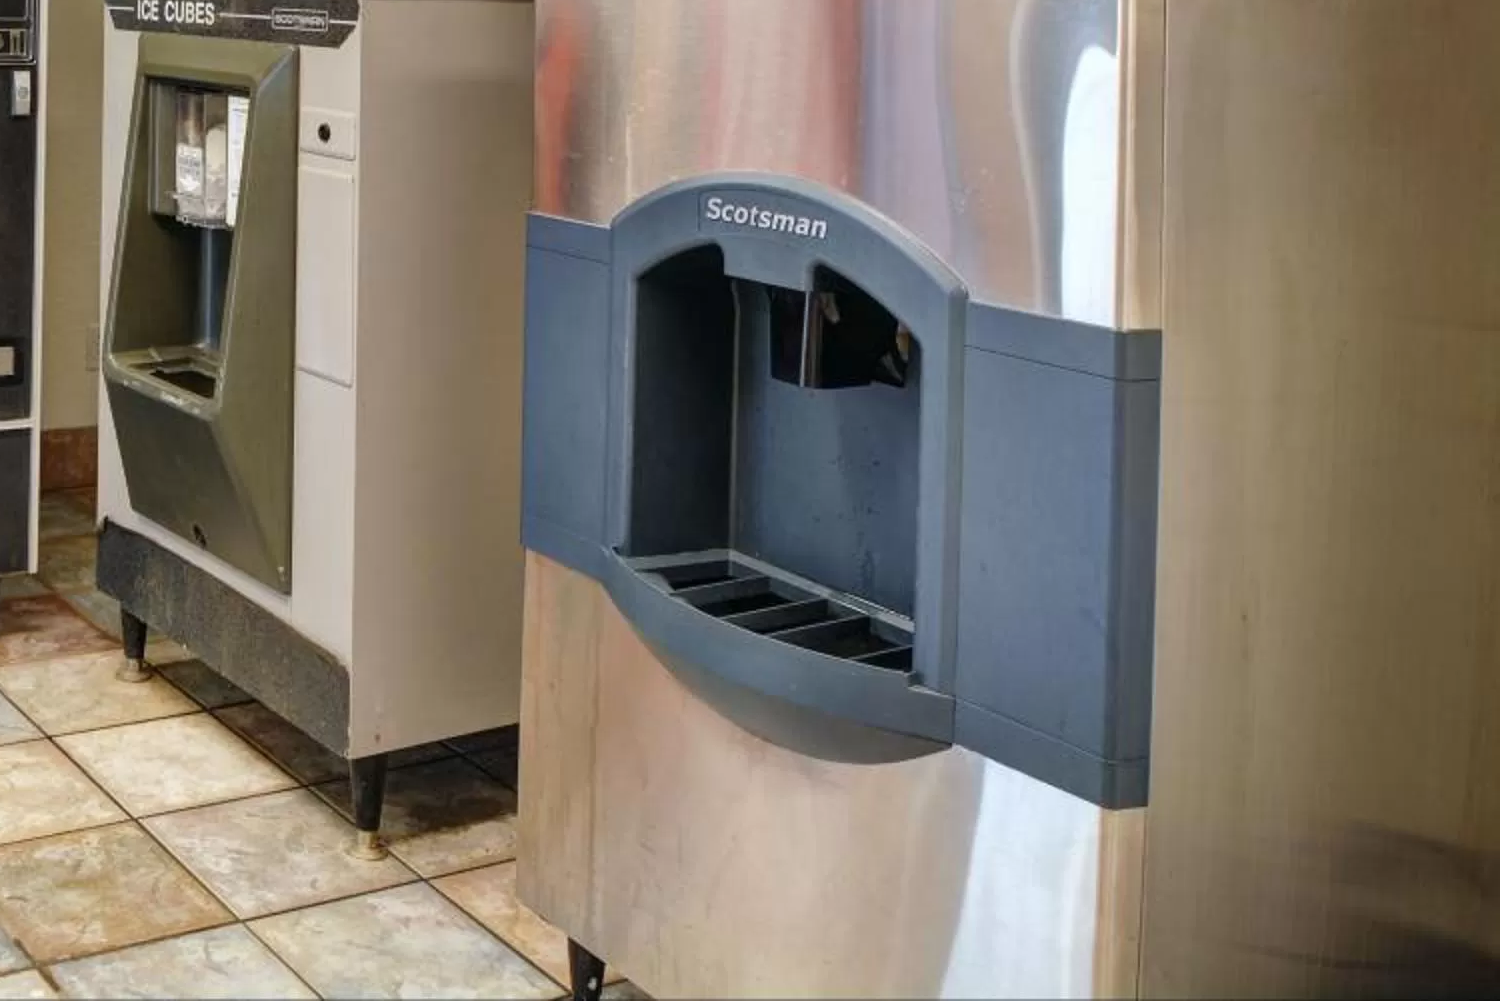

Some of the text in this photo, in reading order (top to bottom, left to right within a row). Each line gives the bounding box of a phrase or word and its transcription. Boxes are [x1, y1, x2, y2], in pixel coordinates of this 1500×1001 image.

[137, 0, 215, 26] ICE CUBES
[706, 197, 828, 239] Scotsman
